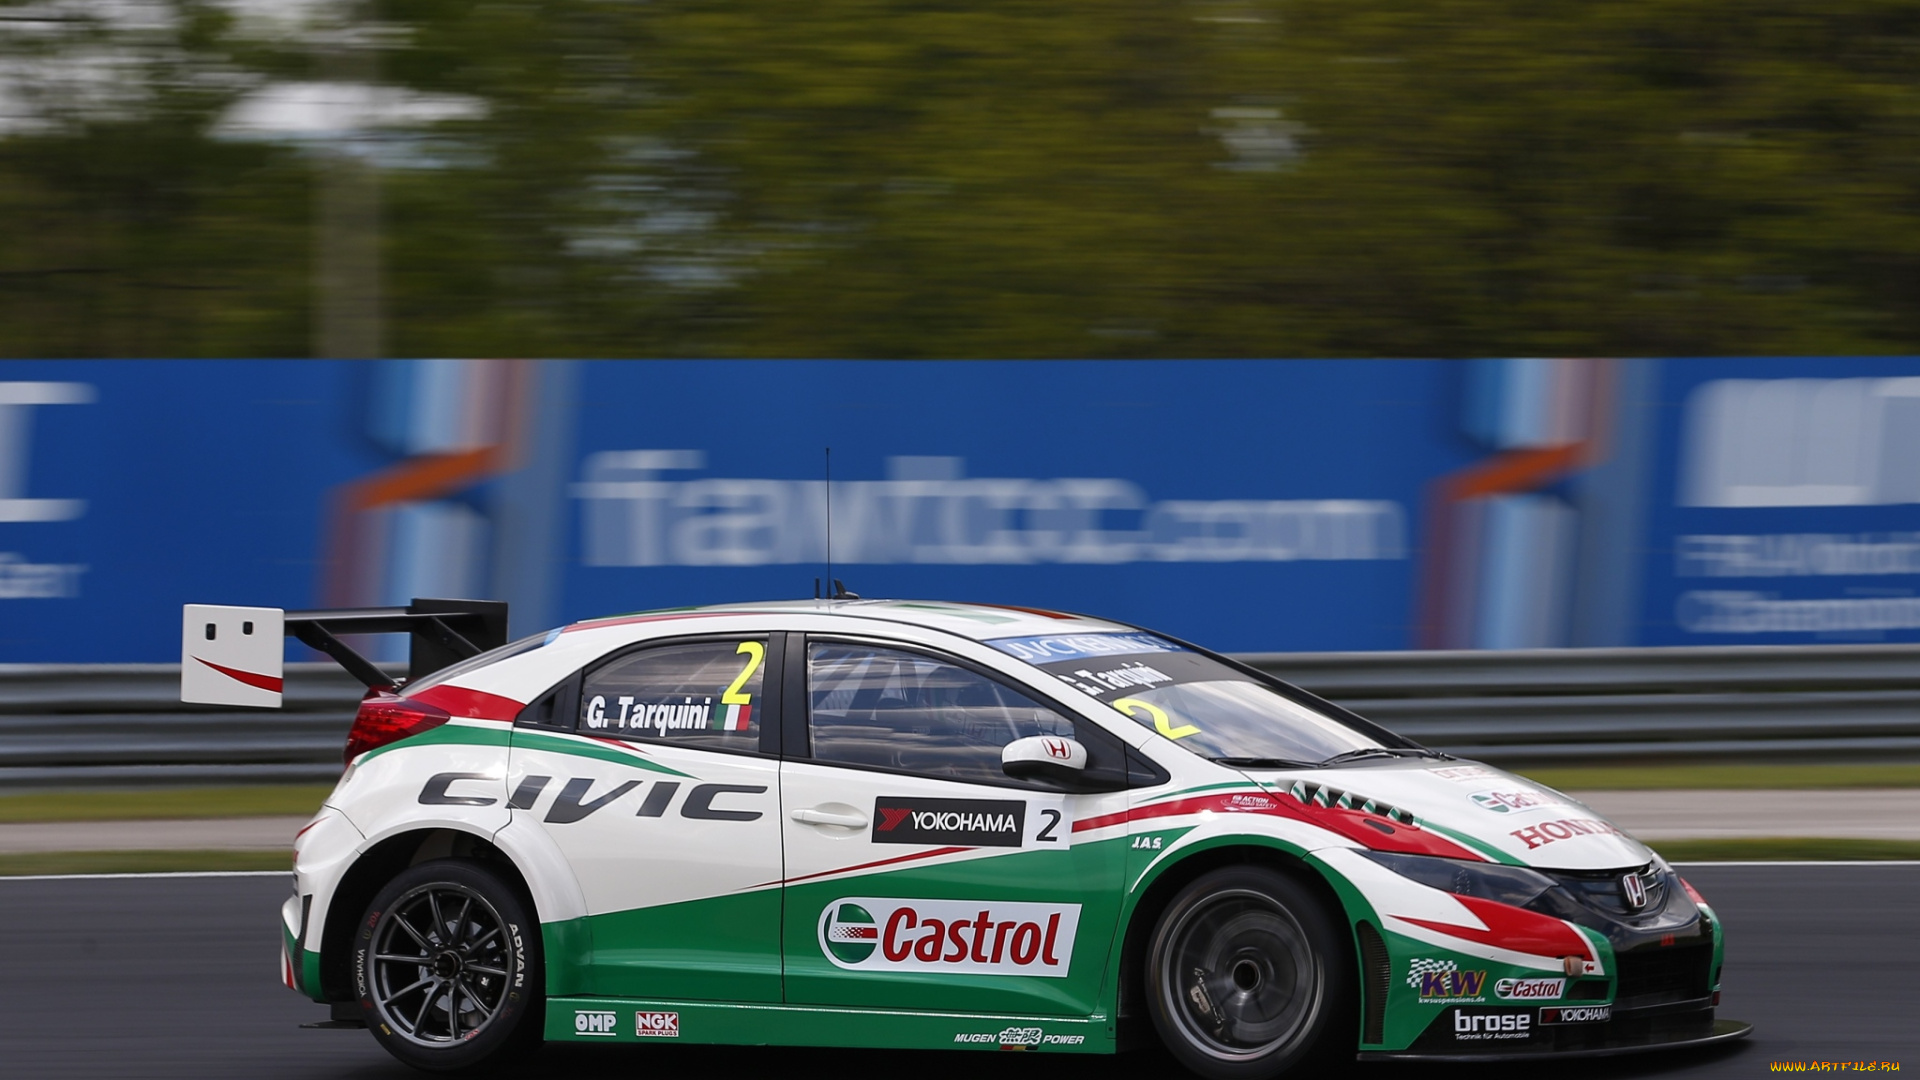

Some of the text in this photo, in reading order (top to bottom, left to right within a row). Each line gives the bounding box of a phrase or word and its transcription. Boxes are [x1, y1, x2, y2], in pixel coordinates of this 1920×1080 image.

[720, 641, 764, 705] 2
[1074, 661, 1173, 689] Tarquini
[587, 695, 711, 737] G. Tarquini
[1112, 698, 1201, 740] 2
[418, 772, 768, 824] CIVIC
[911, 809, 1061, 842] YOKOHAMA 2
[1510, 819, 1631, 849] HONDA
[882, 907, 1061, 965] Castrol
[508, 923, 525, 988] ADVAN
[356, 949, 367, 997] YOKOHAMA
[1420, 970, 1487, 998] KW
[1513, 979, 1562, 997] Castrol
[575, 1014, 616, 1031] OMP
[638, 1013, 677, 1030] NGK
[1455, 1009, 1530, 1032] brose
[1560, 1008, 1611, 1022] YOKOHAMA
[954, 1033, 997, 1043] MUGEN
[1042, 1034, 1085, 1044] POWER
